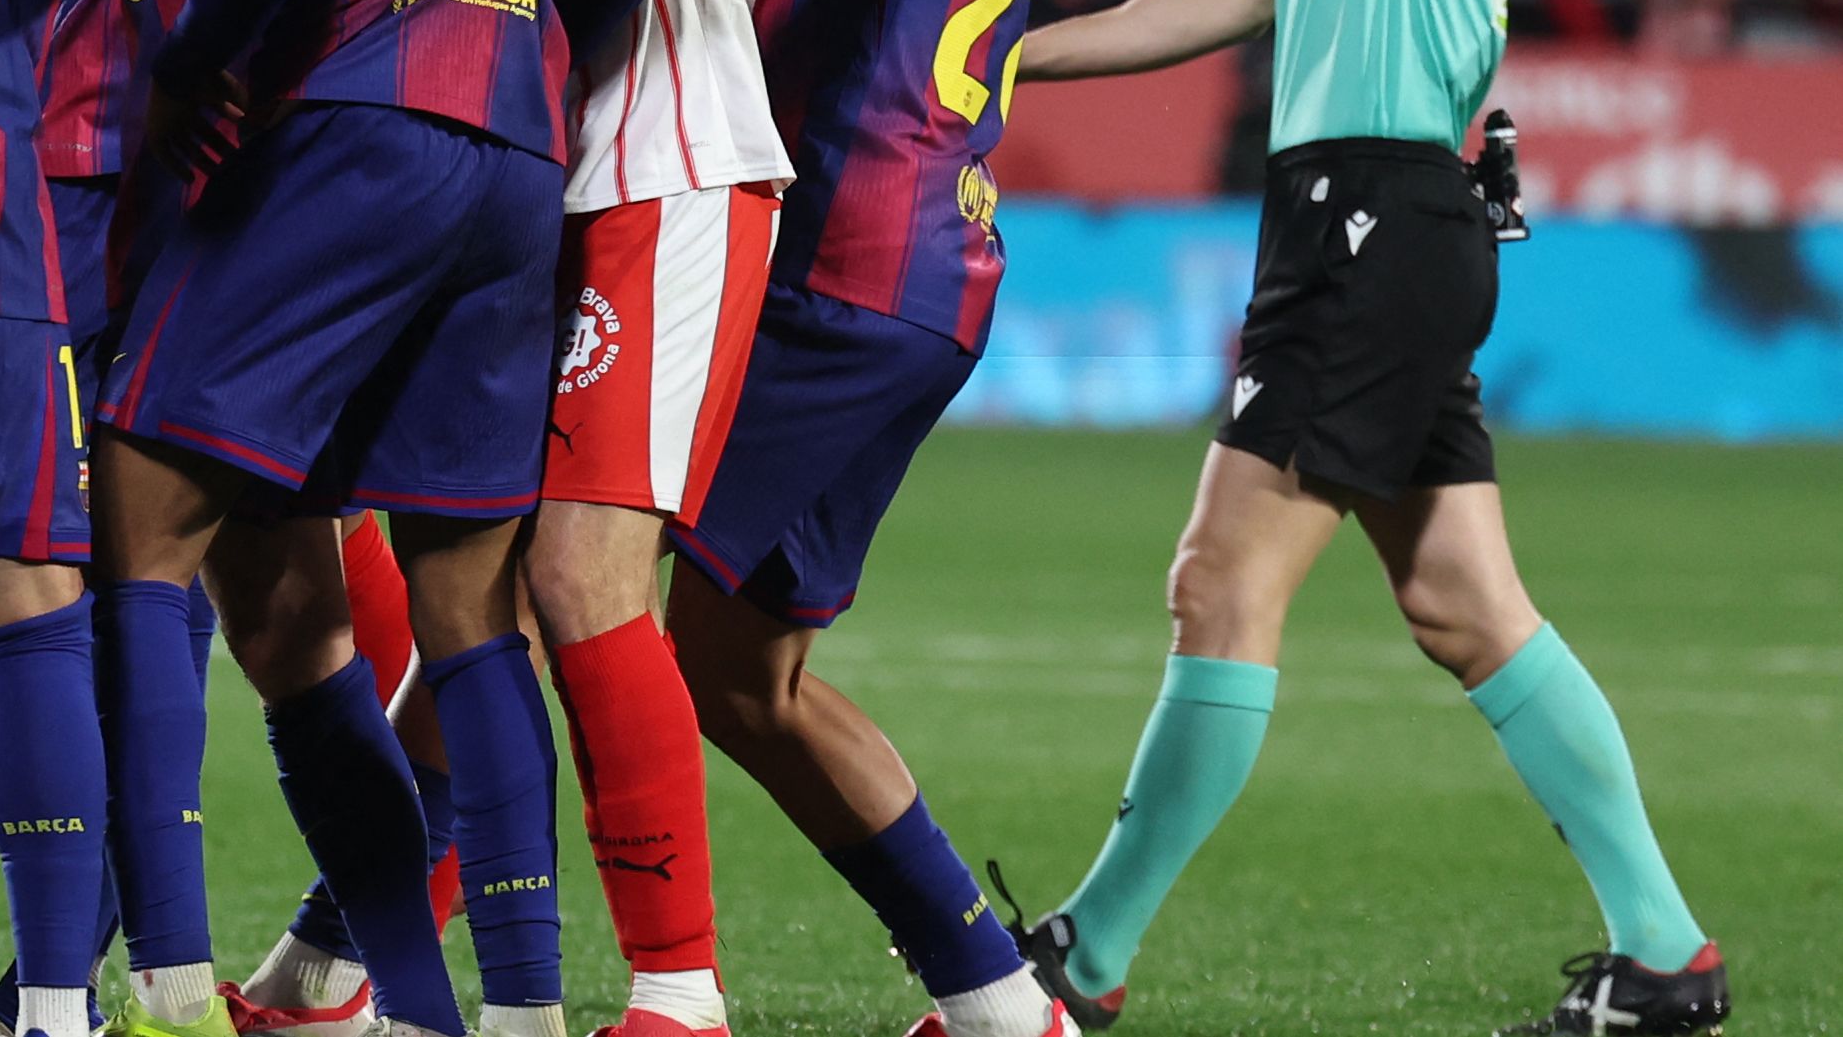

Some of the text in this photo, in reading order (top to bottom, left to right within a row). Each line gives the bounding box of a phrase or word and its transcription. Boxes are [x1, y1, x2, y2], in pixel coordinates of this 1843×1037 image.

[580, 286, 620, 334] Brava
[557, 343, 620, 394] de Girona
[2, 817, 84, 835] BARÇA
[484, 875, 550, 896] BARÇA
